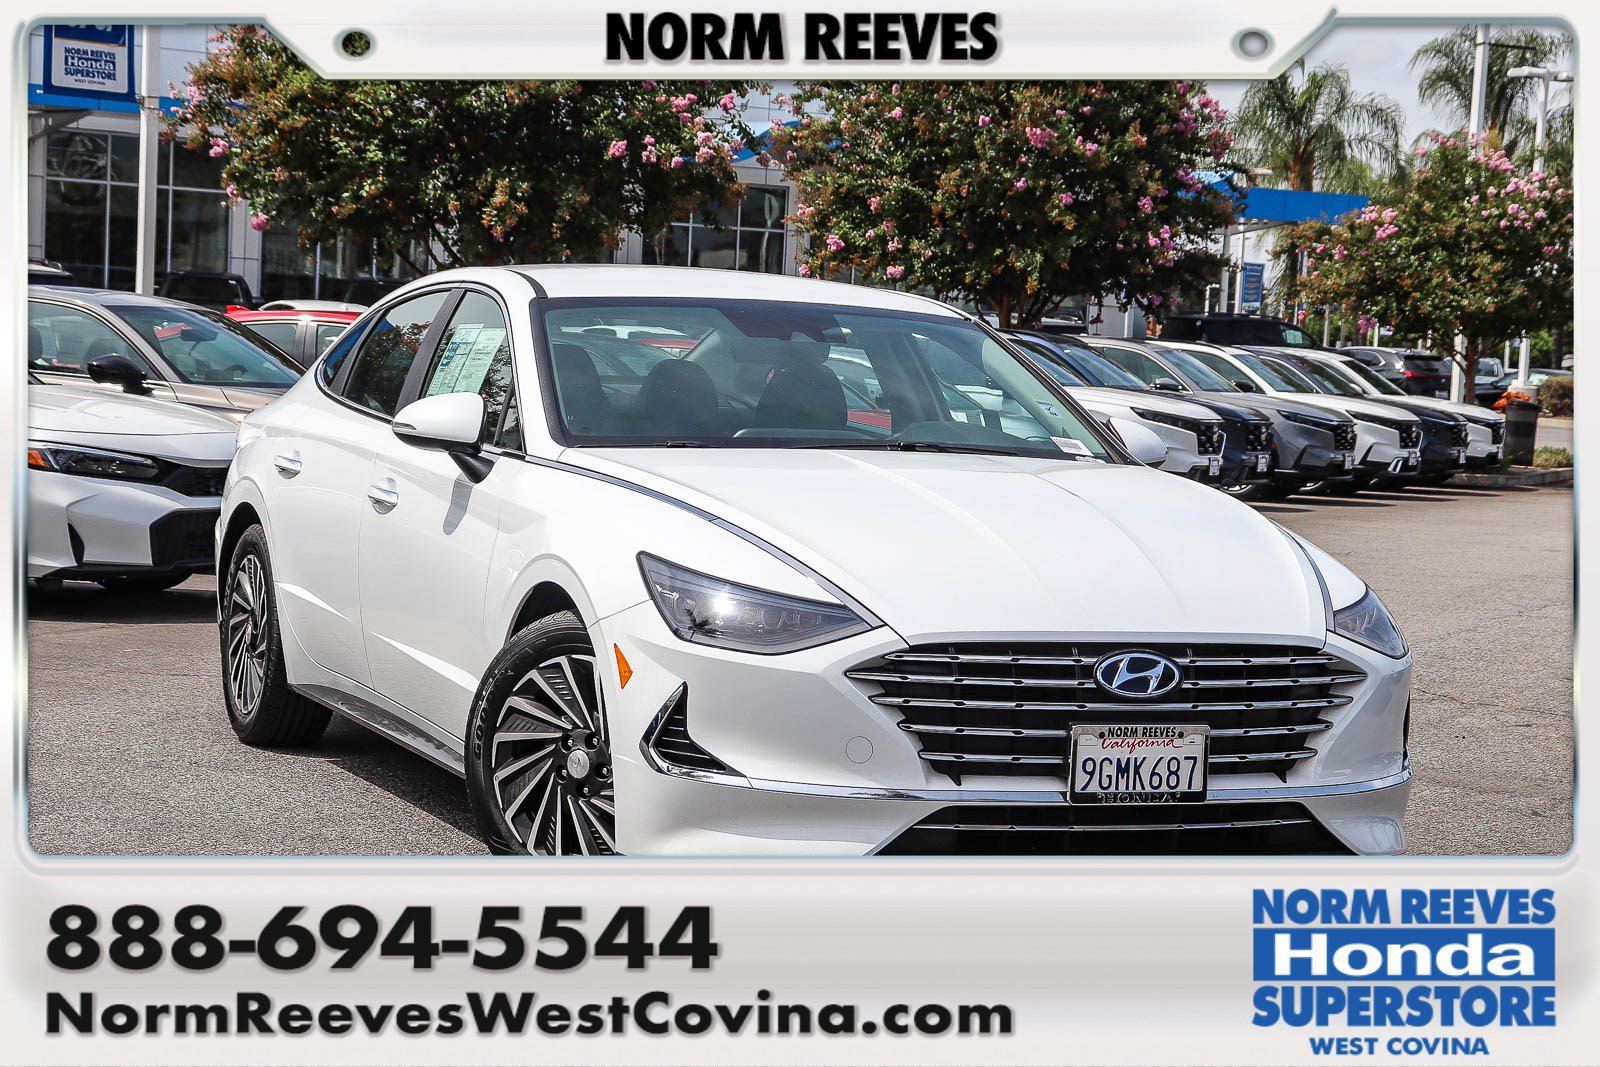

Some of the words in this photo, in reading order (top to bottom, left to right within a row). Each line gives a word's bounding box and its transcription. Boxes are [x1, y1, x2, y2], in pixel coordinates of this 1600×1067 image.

[64, 46, 89, 57] NORM
[90, 50, 116, 60] REEVES
[68, 56, 113, 70] Honda
[64, 67, 116, 81] SUPERSTORE
[1108, 727, 1138, 738] NORM
[1141, 726, 1176, 738] REEVES
[1101, 738, 1183, 755] California
[1080, 756, 1198, 791] 9GMK687
